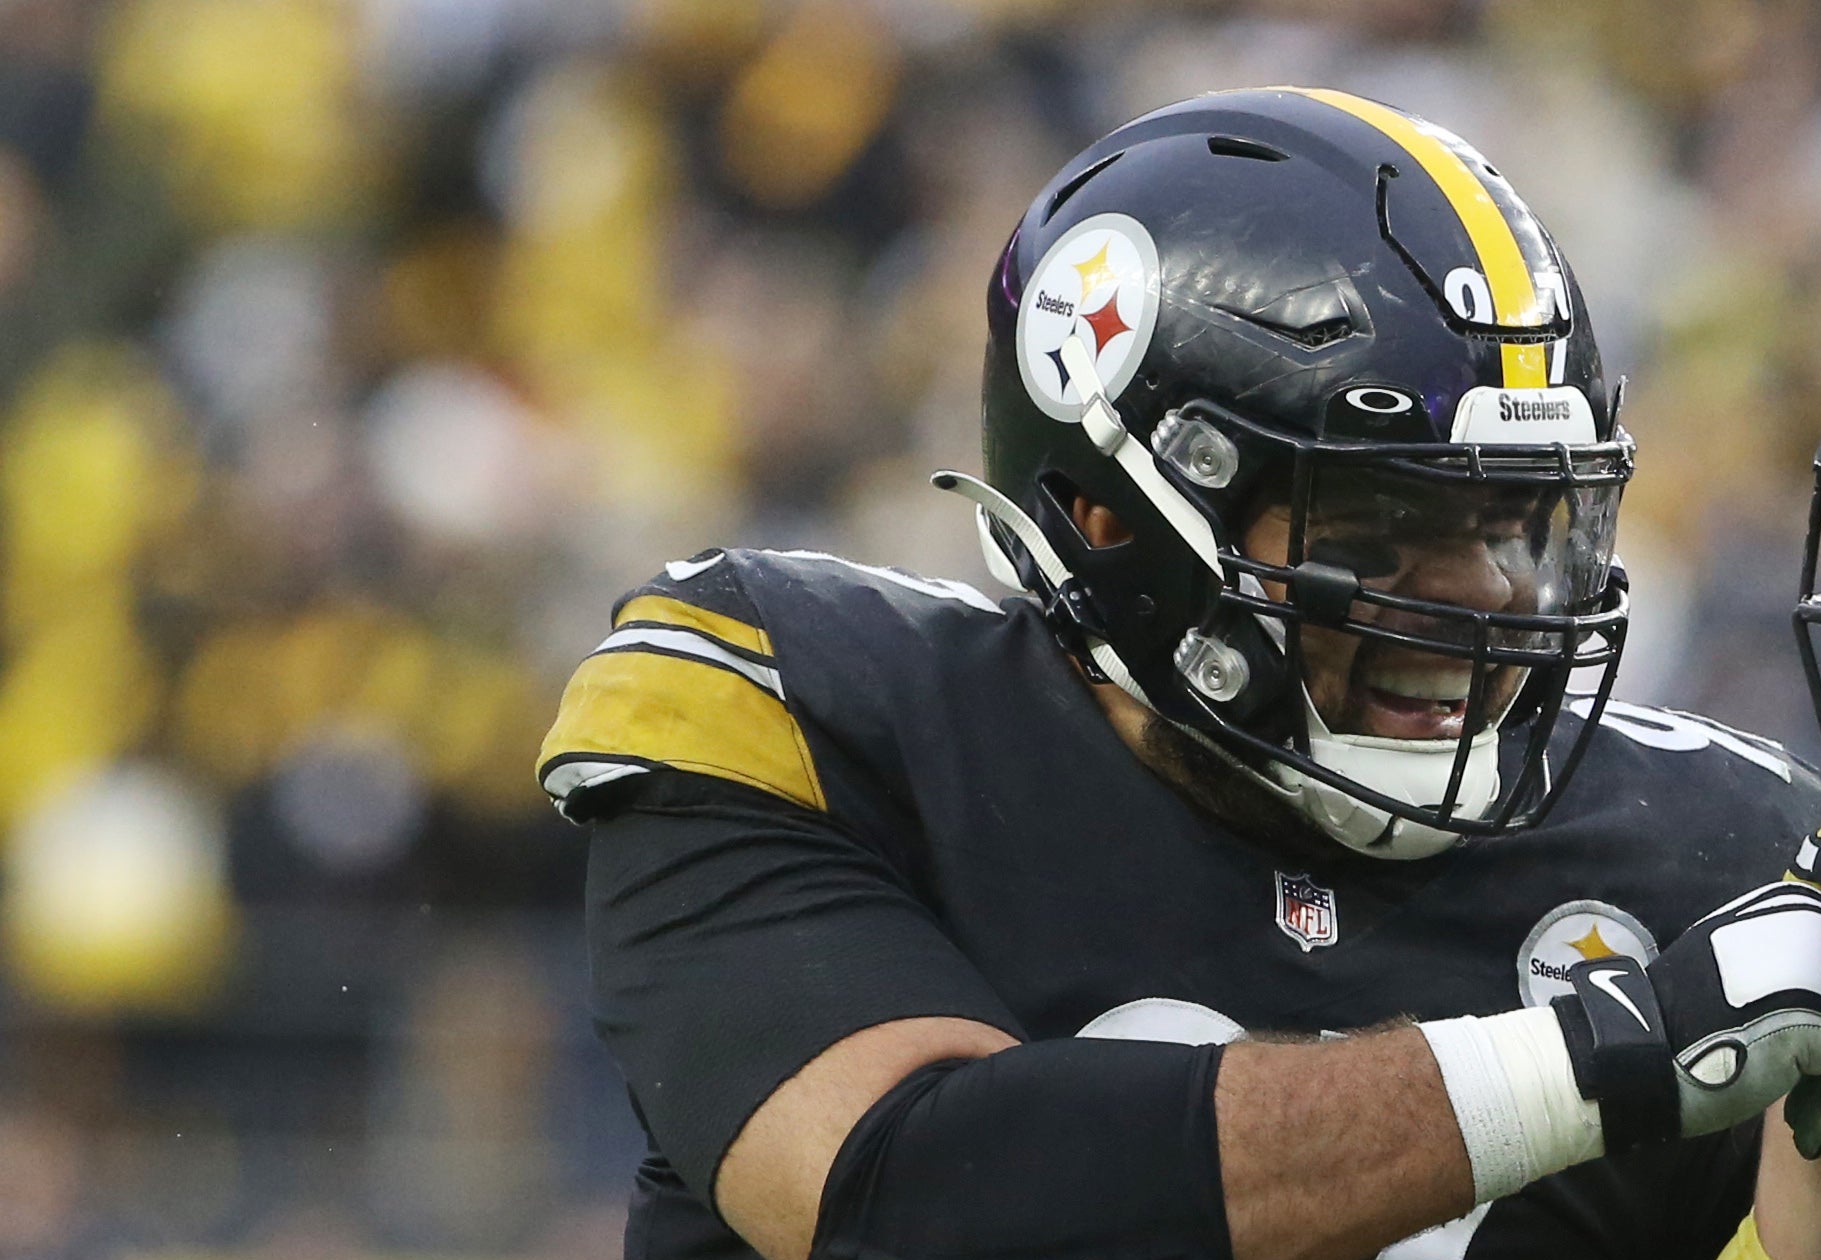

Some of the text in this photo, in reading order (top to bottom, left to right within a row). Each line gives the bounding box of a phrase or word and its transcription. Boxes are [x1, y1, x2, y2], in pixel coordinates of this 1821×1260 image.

[1035, 289, 1075, 317] Steelers
[1498, 392, 1571, 422] Steelers
[1287, 901, 1328, 936] NFL
[1530, 957, 1572, 982] Steele
